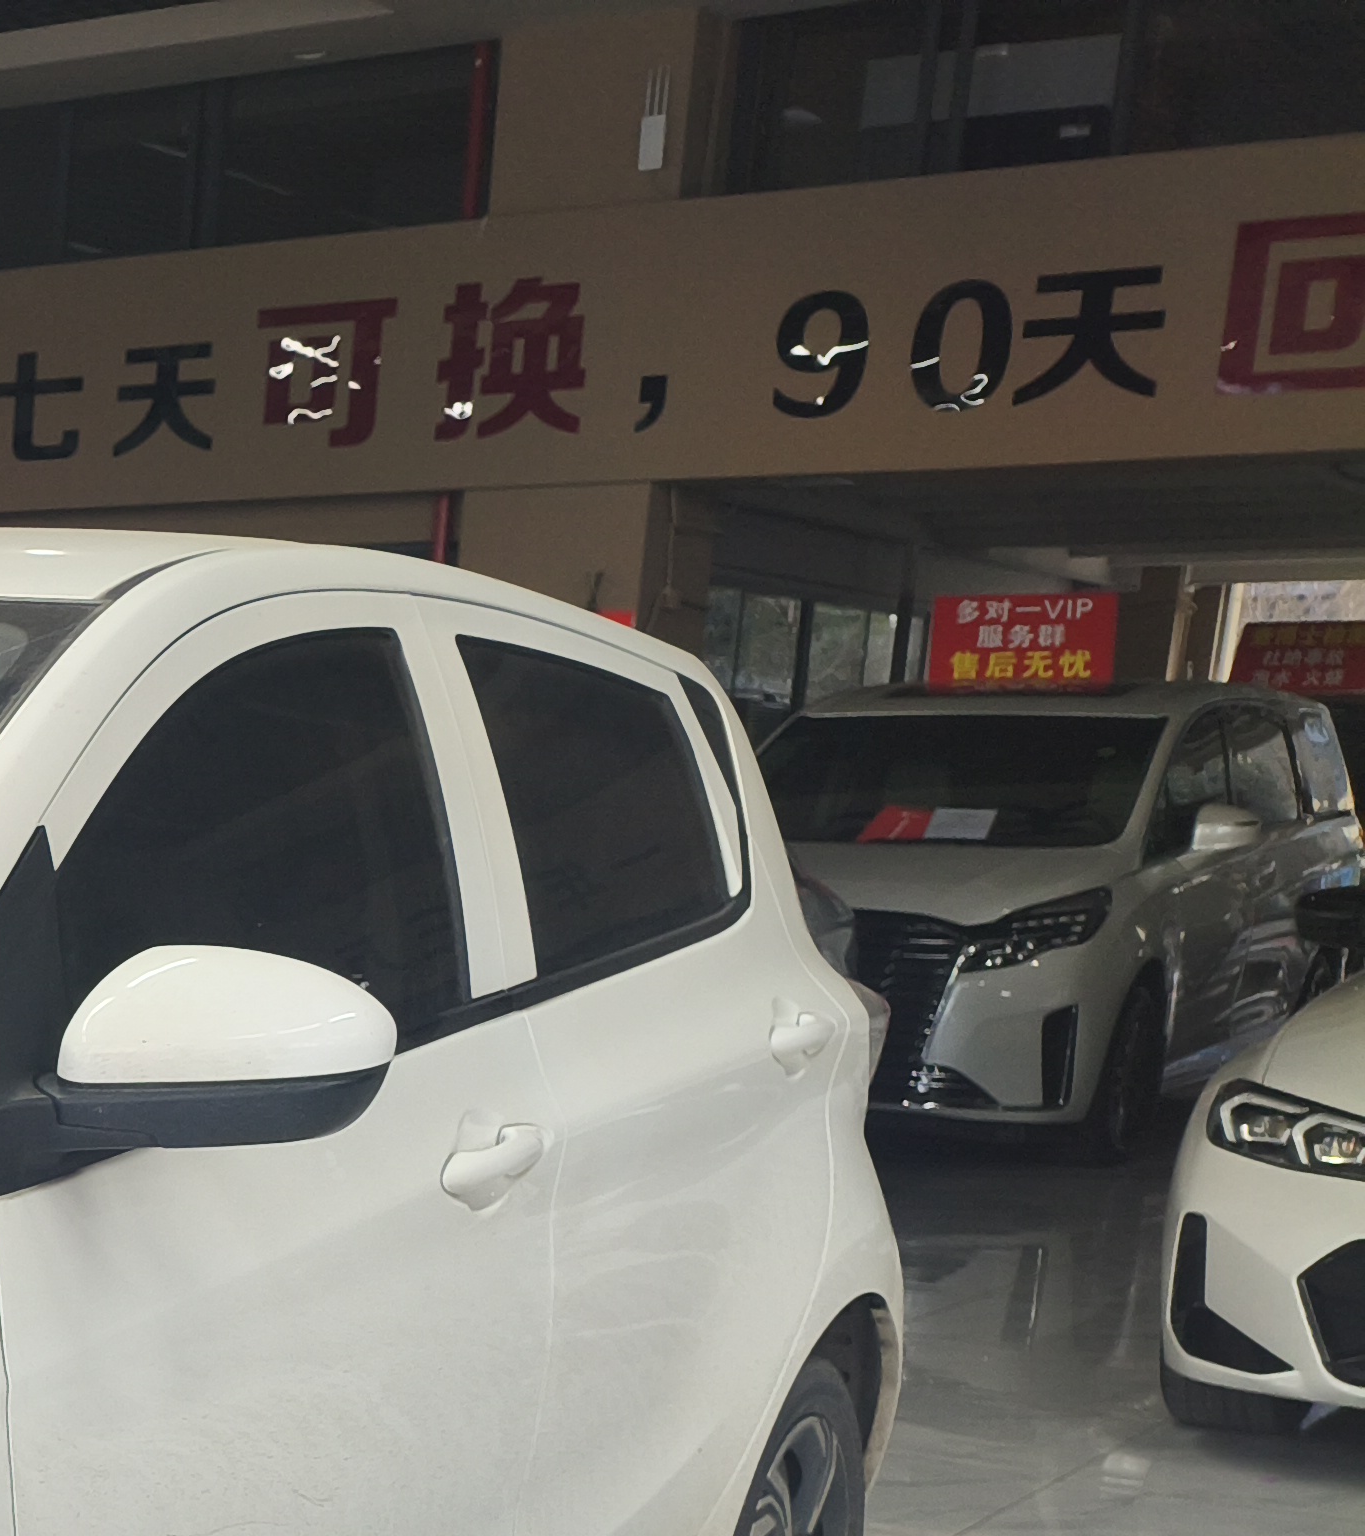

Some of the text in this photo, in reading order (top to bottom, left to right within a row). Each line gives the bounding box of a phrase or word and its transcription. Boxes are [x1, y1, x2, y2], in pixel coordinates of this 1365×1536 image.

[956, 597, 1094, 624] 多对一VIP
[977, 624, 1066, 649] 服务群
[950, 650, 1092, 680] 售后无忧
